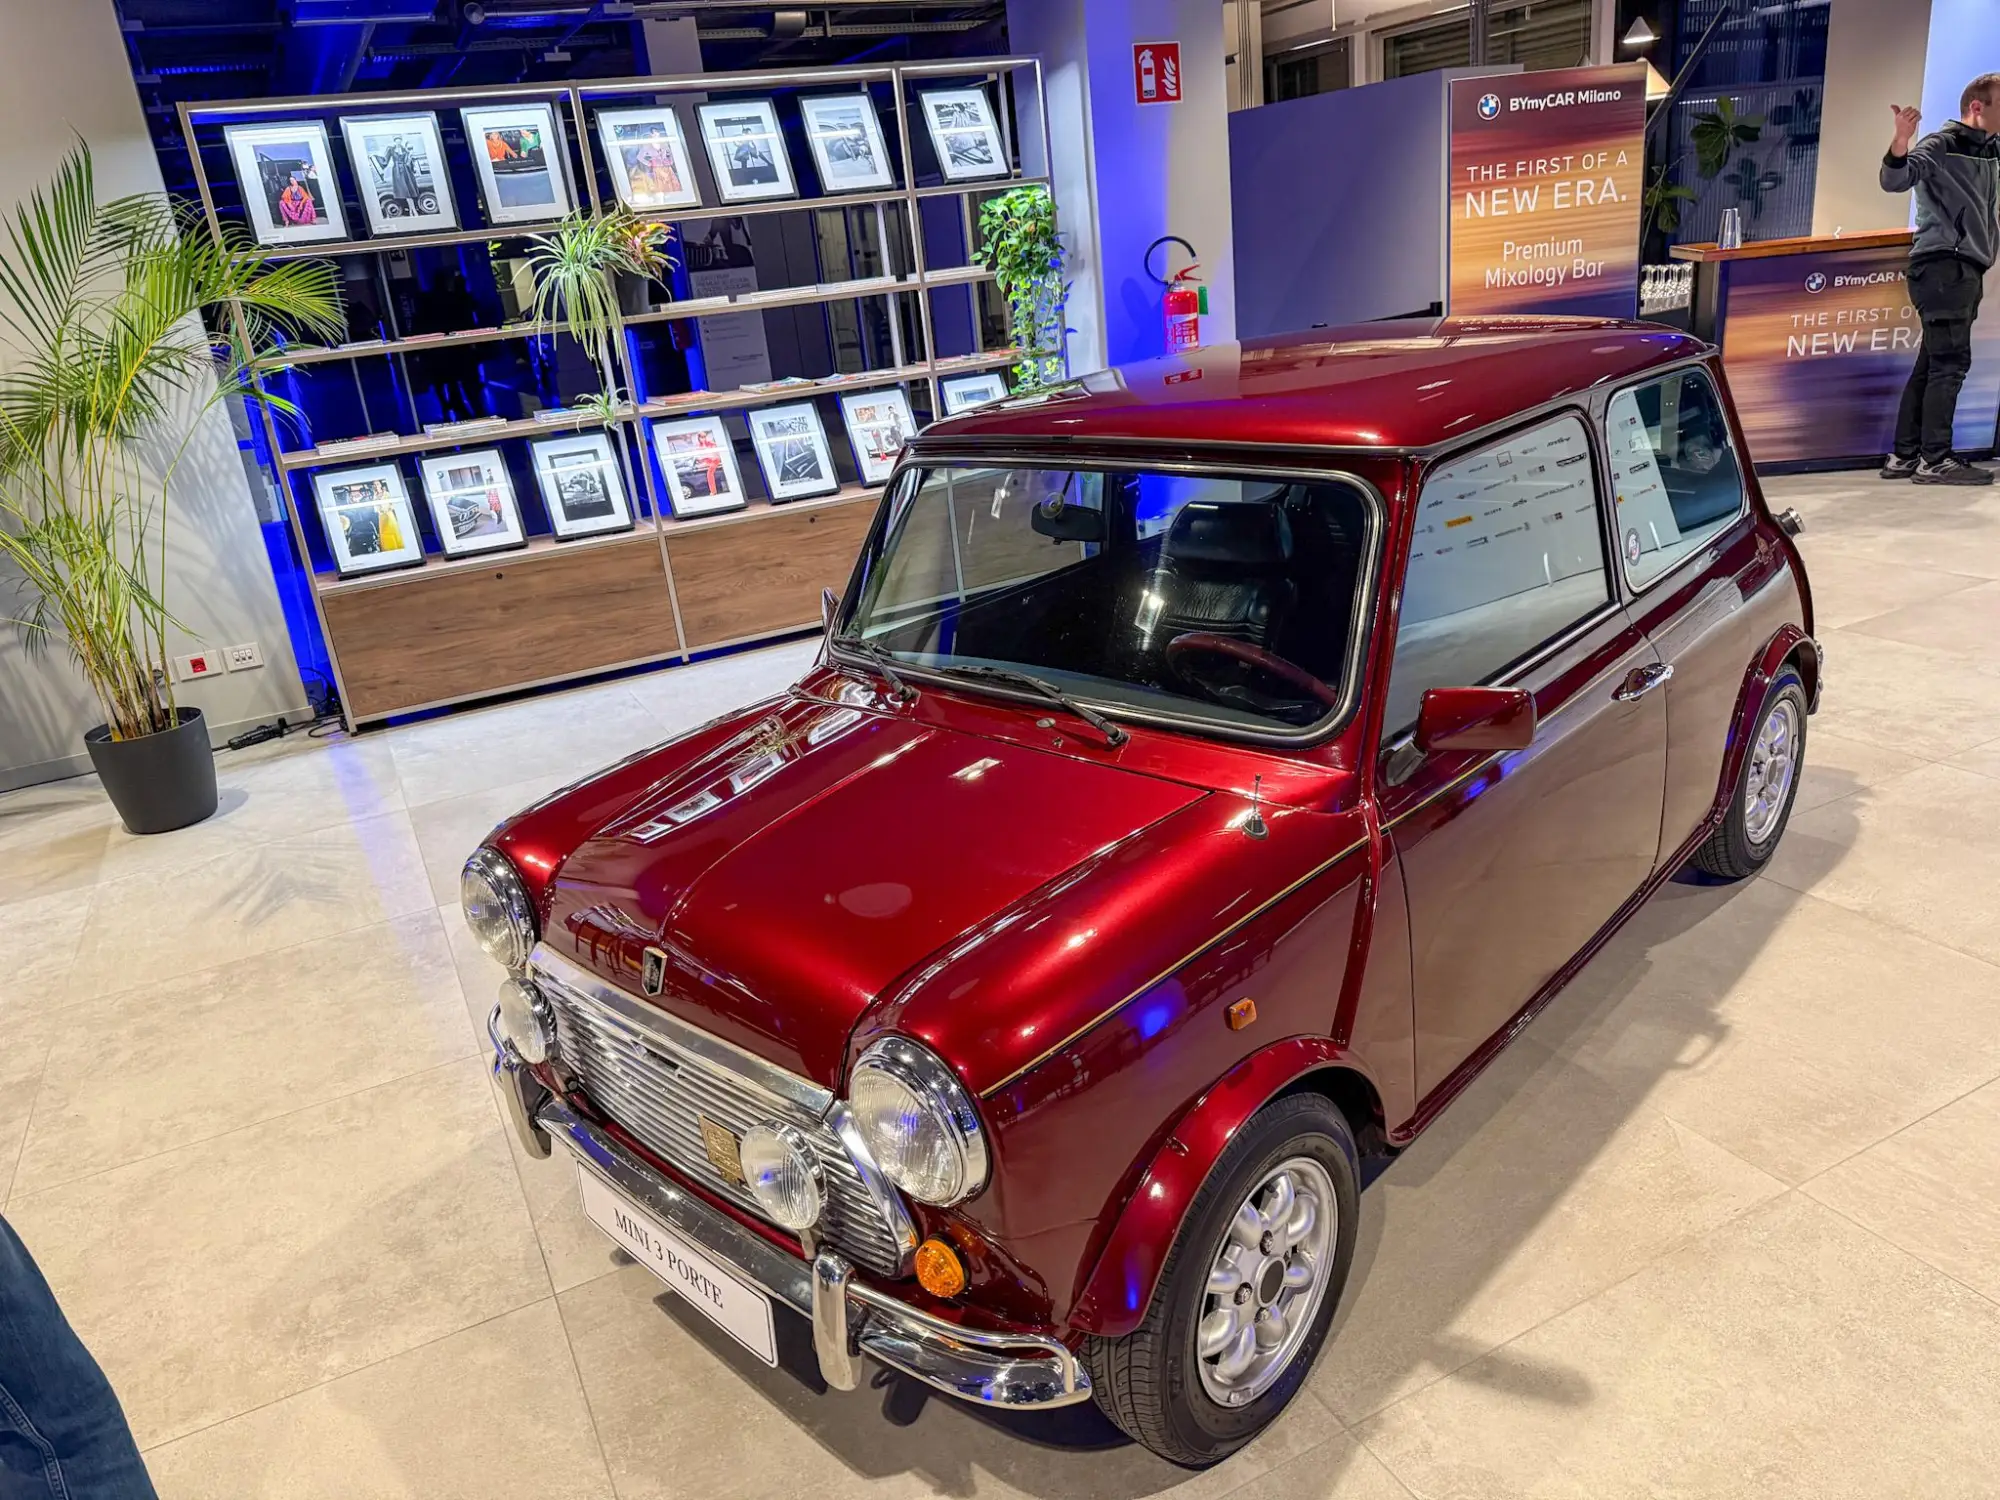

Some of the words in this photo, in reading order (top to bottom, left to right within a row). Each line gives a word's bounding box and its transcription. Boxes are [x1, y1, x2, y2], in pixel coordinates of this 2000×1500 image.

[1509, 92, 1575, 111] BYmyCAR
[1578, 90, 1621, 104] Milano
[1466, 163, 1507, 182] THE
[1516, 156, 1574, 177] FIRST
[1582, 152, 1607, 170] OF
[1616, 150, 1628, 167] A
[1465, 184, 1539, 219] NEW
[1554, 176, 1627, 209] ERA.
[1503, 236, 1582, 262] Premium
[1485, 264, 1567, 289] Mixology
[1572, 259, 1604, 279] Bar
[1834, 271, 1894, 287] BYmyCAR
[1790, 312, 1828, 328] THE
[1836, 307, 1893, 325] FIRST
[1787, 330, 1858, 357] NEW
[613, 1207, 652, 1253] MINI
[653, 1240, 664, 1261] 3
[666, 1248, 724, 1309] PORTE
